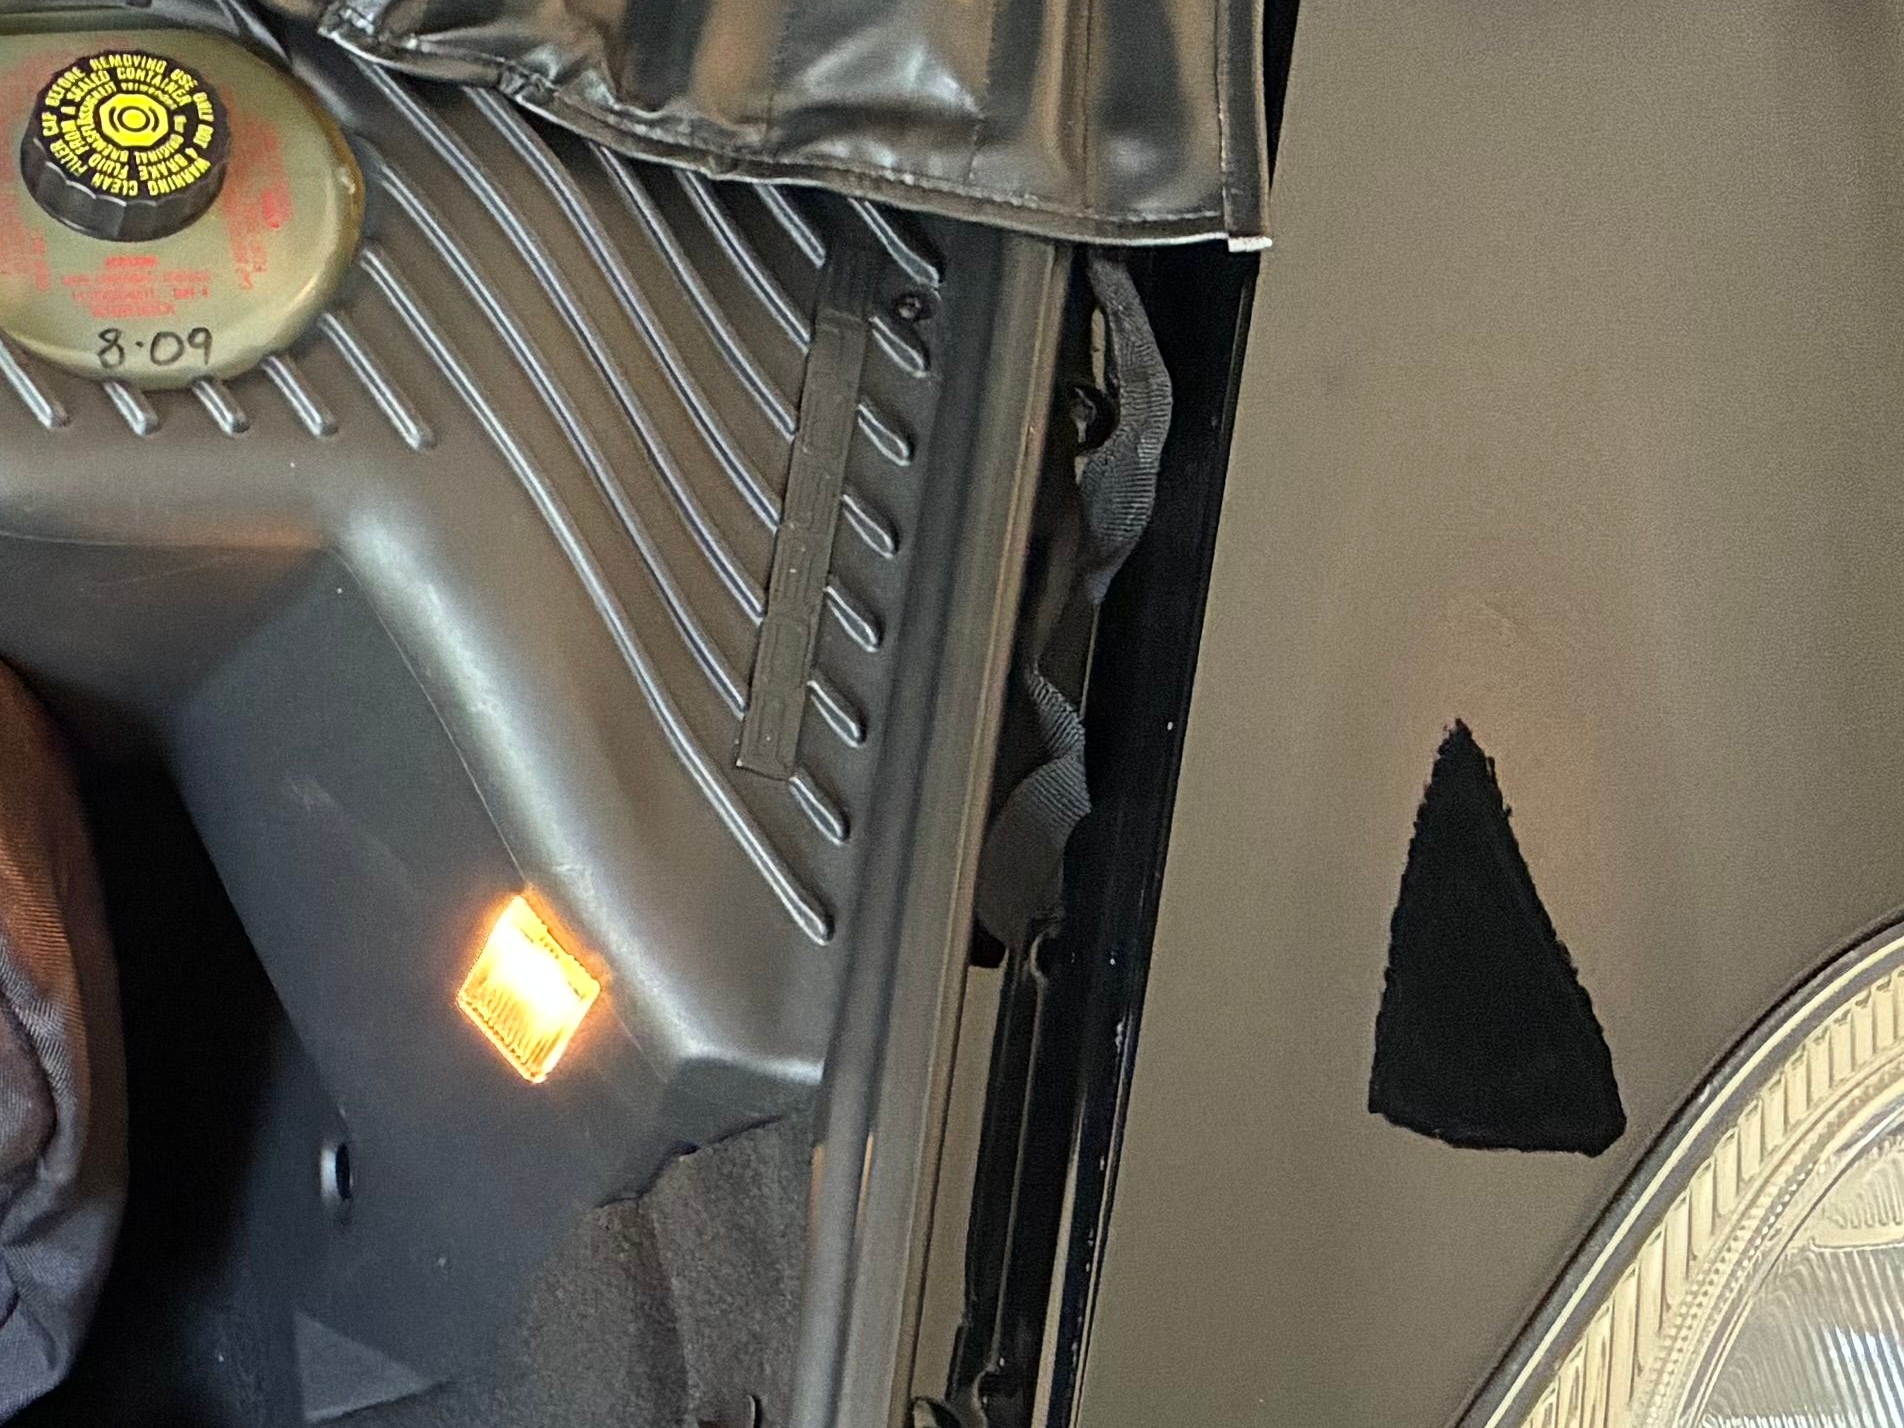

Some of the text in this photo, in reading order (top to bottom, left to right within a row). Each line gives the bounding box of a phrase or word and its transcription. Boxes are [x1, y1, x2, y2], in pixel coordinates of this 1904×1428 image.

[90, 54, 168, 73] REMOVING
[45, 66, 86, 107] BEFORE
[67, 70, 111, 103] SEALED
[116, 67, 193, 107] CONTAINER
[170, 68, 198, 90] USE
[60, 105, 76, 116] A
[60, 120, 90, 157] FROM
[50, 139, 88, 178] FILLER
[88, 153, 129, 179] FLUID
[138, 153, 189, 181] BRAKE
[184, 147, 199, 159] 4
[90, 174, 139, 197] CLEAN
[147, 157, 211, 196] WARNING
